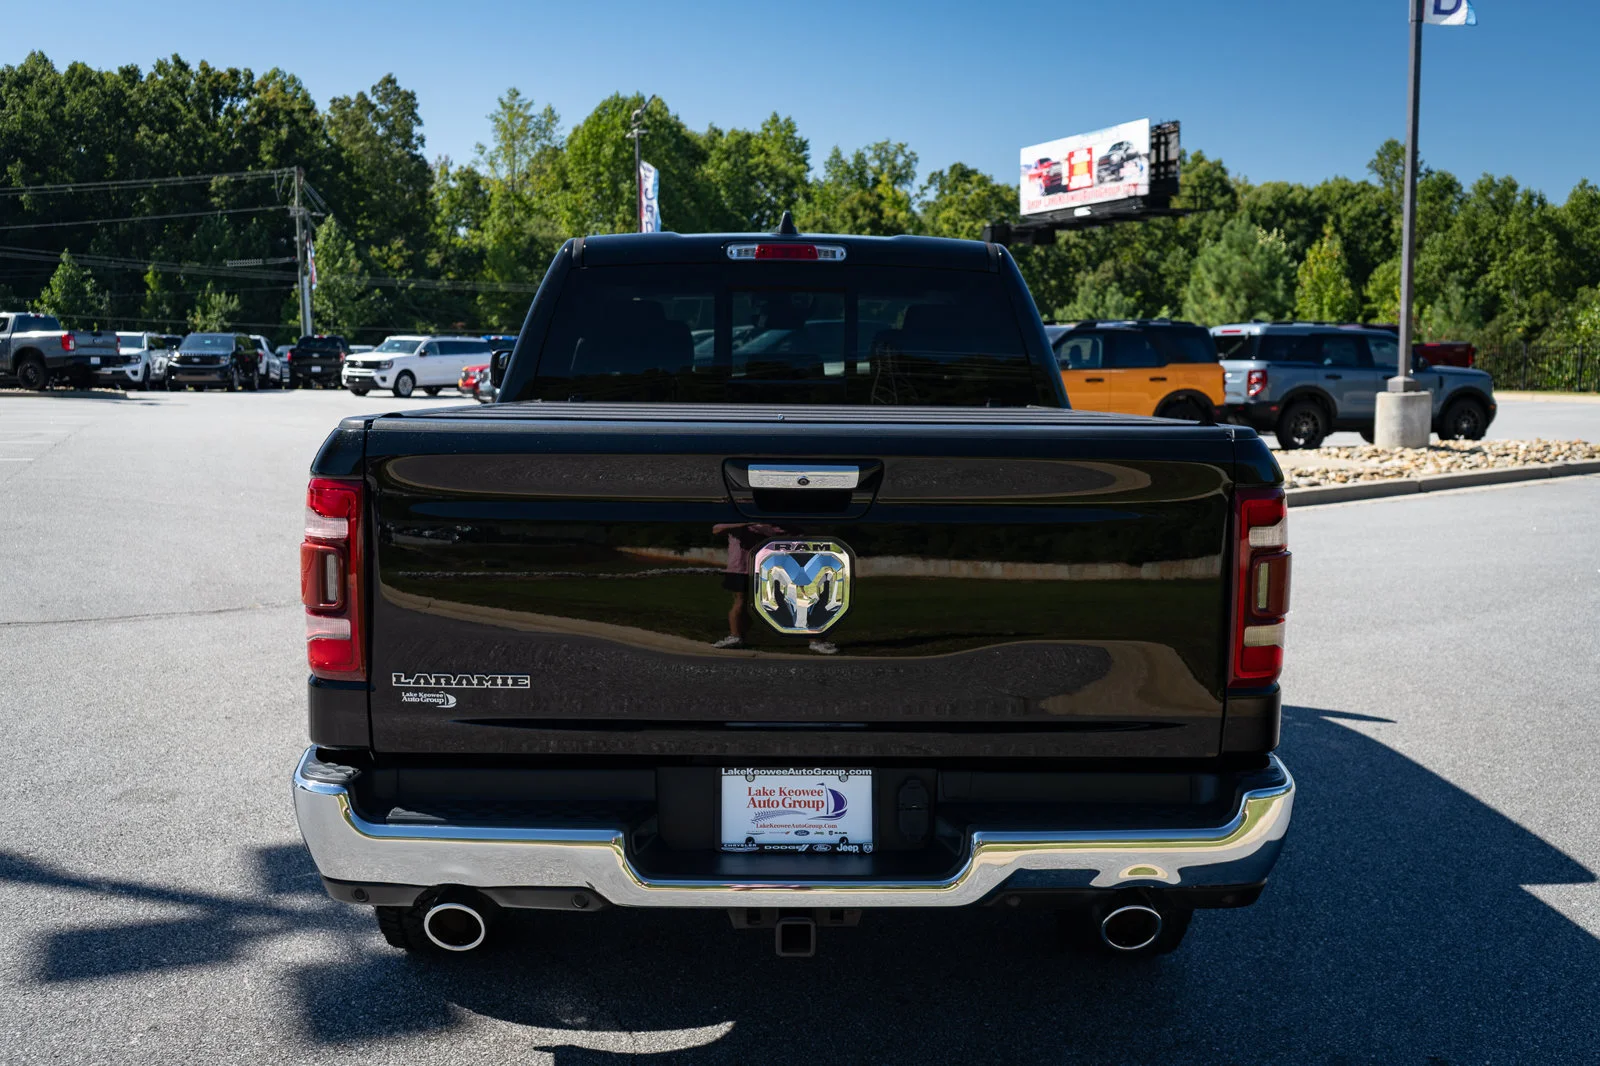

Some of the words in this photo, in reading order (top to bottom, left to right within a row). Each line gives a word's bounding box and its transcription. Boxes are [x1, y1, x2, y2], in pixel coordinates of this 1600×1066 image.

[774, 543, 831, 551] RAM
[392, 673, 530, 688] LARAMIE
[420, 697, 444, 705] Group
[721, 767, 872, 776] LakeKeoweeAutoGroup.com
[747, 786, 776, 797] Lake
[778, 786, 824, 797] Keowee
[746, 797, 779, 809] Auto
[781, 796, 825, 811] Group
[836, 843, 859, 853] Jeep
